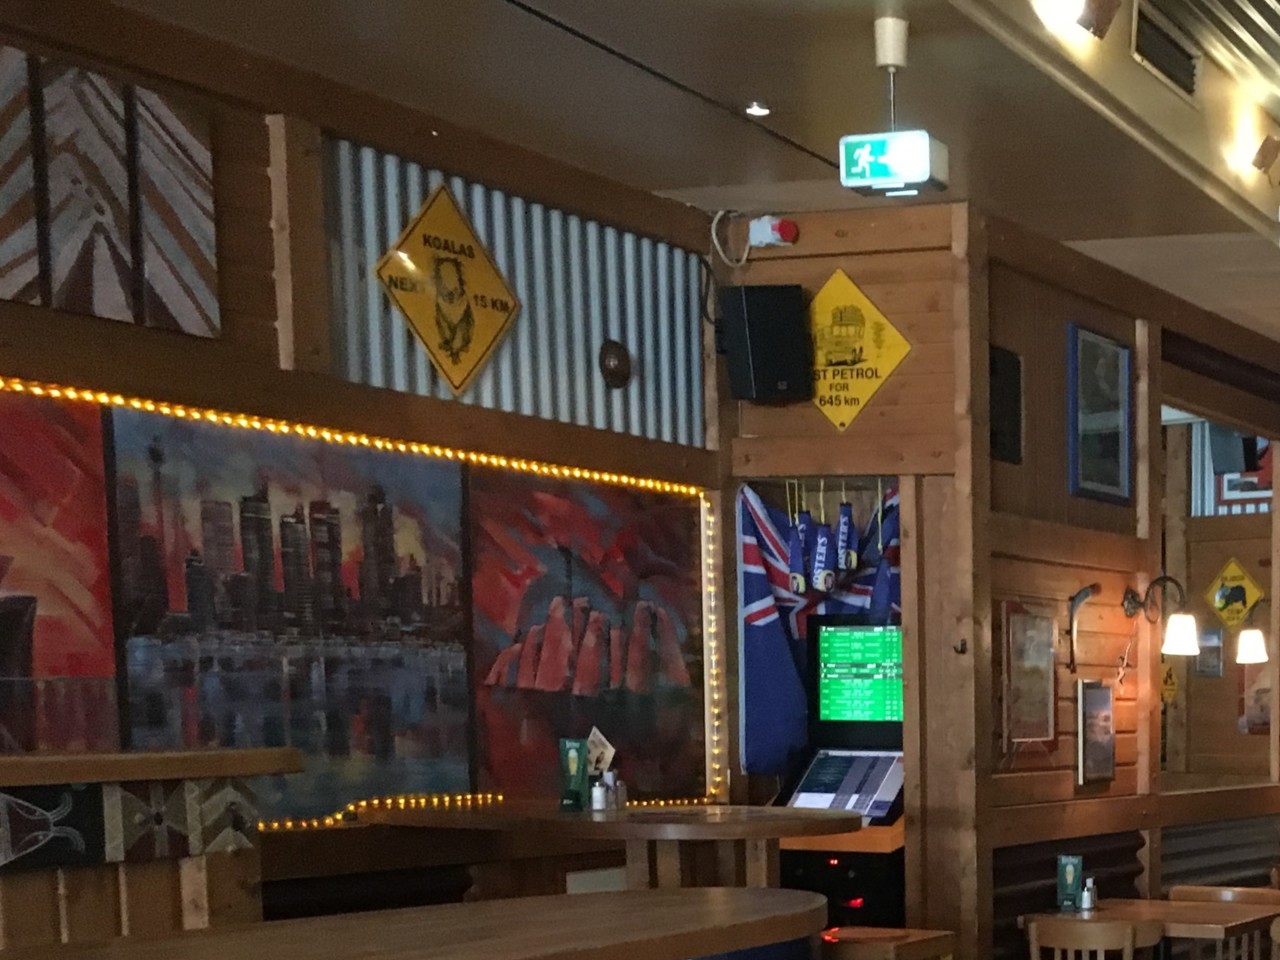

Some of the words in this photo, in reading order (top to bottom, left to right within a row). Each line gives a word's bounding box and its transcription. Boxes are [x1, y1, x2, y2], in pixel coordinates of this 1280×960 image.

[422, 233, 475, 258] KOALAS
[472, 294, 488, 309] 15
[491, 297, 510, 313] KM
[813, 369, 829, 381] ST
[832, 367, 882, 380] PETROL
[829, 382, 849, 393] FOR
[819, 394, 842, 407] 645
[844, 394, 860, 406] km
